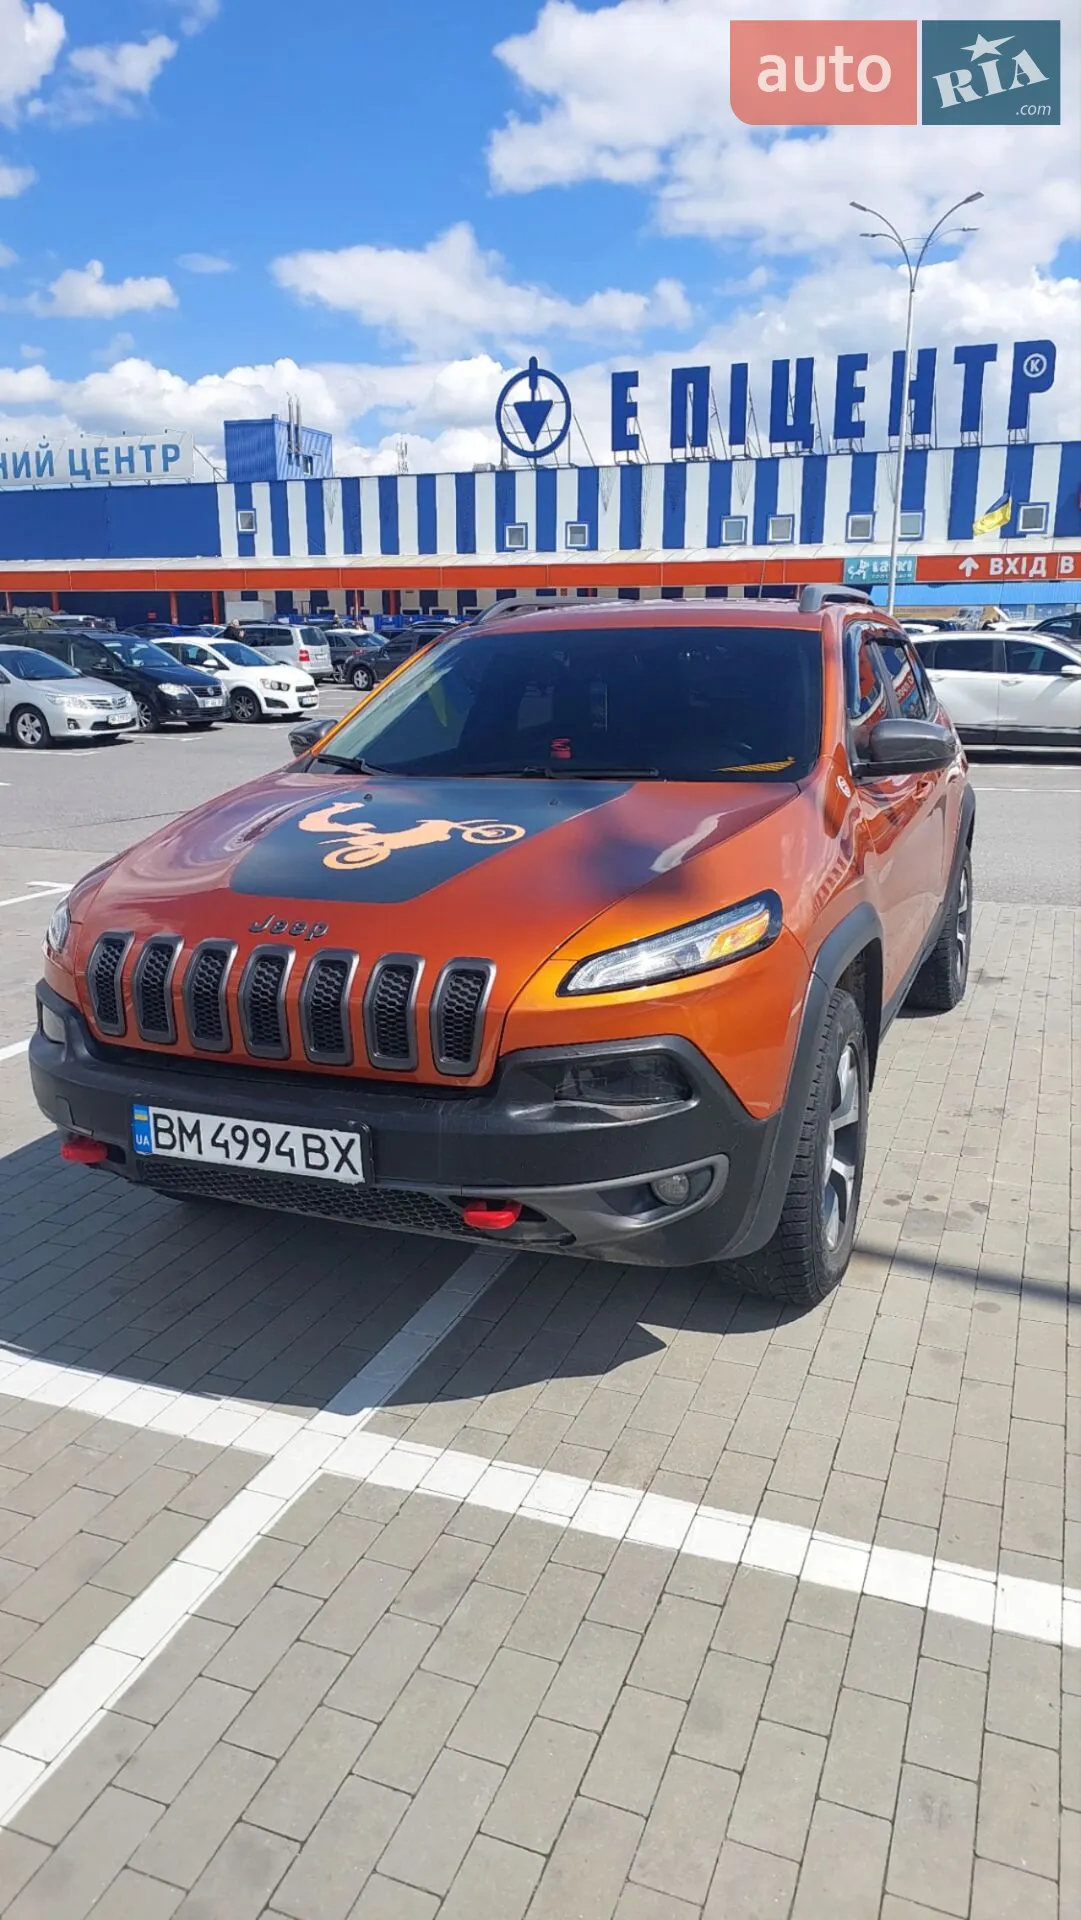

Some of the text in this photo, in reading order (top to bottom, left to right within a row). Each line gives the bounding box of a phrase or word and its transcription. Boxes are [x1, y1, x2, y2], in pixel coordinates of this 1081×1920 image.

[611, 339, 1057, 452] ЕПІЦЕНТР
[68, 444, 180, 481] ЦЕНТР
[989, 555, 1075, 578] ВХІД В
[249, 912, 329, 941] Jeep
[135, 1134, 150, 1147] UA
